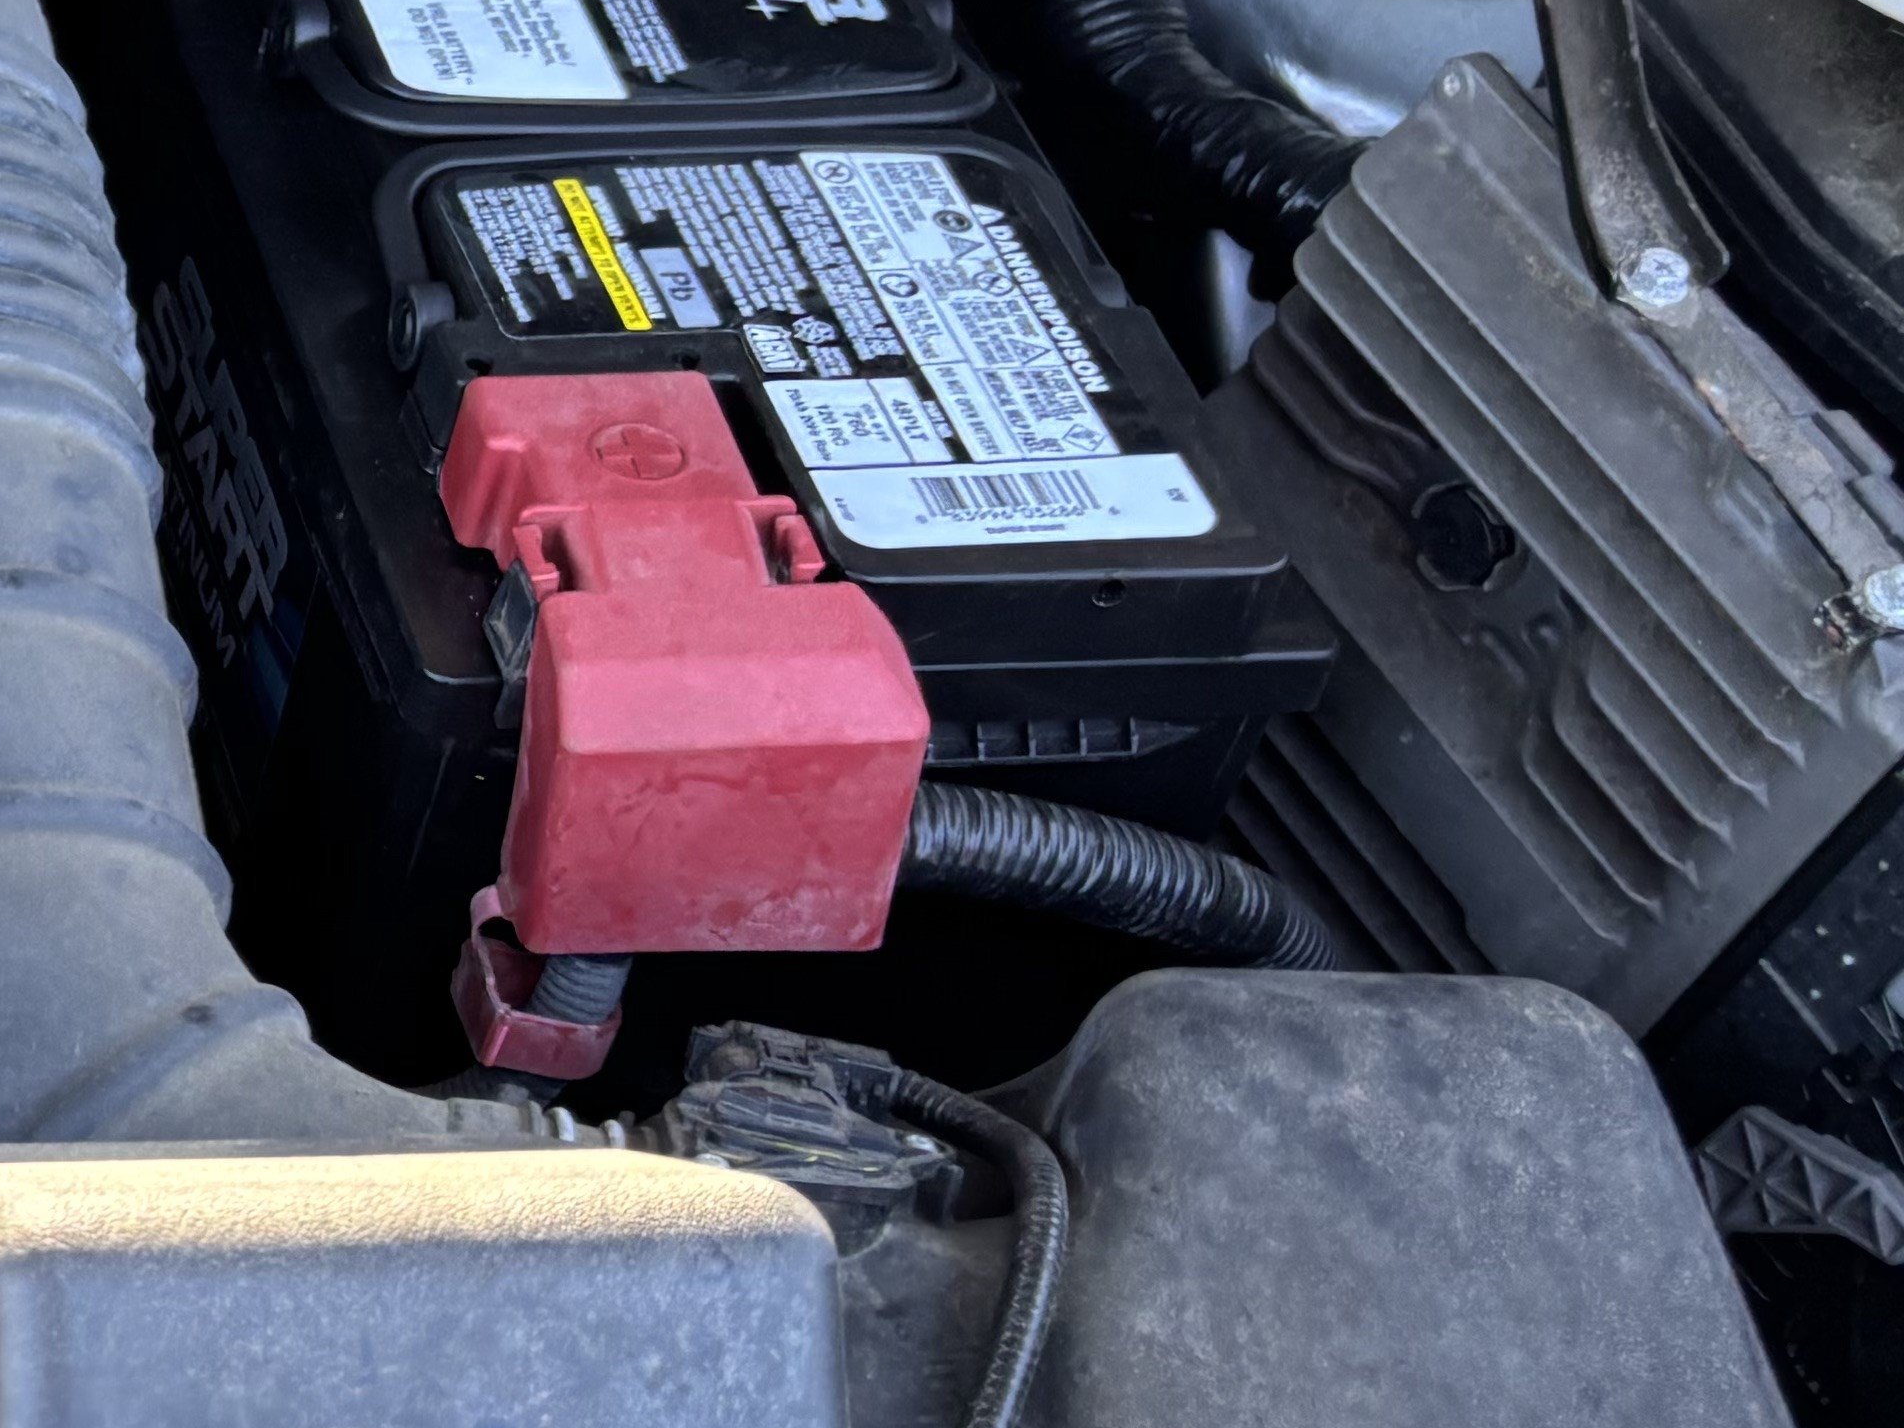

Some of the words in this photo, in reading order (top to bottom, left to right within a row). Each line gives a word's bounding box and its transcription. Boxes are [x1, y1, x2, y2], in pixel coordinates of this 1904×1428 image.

[660, 272, 697, 302] Pb
[985, 225, 1111, 392] DANGER/POISON
[141, 281, 274, 620] START
[179, 256, 288, 593] SUPER
[843, 411, 871, 436] 760
